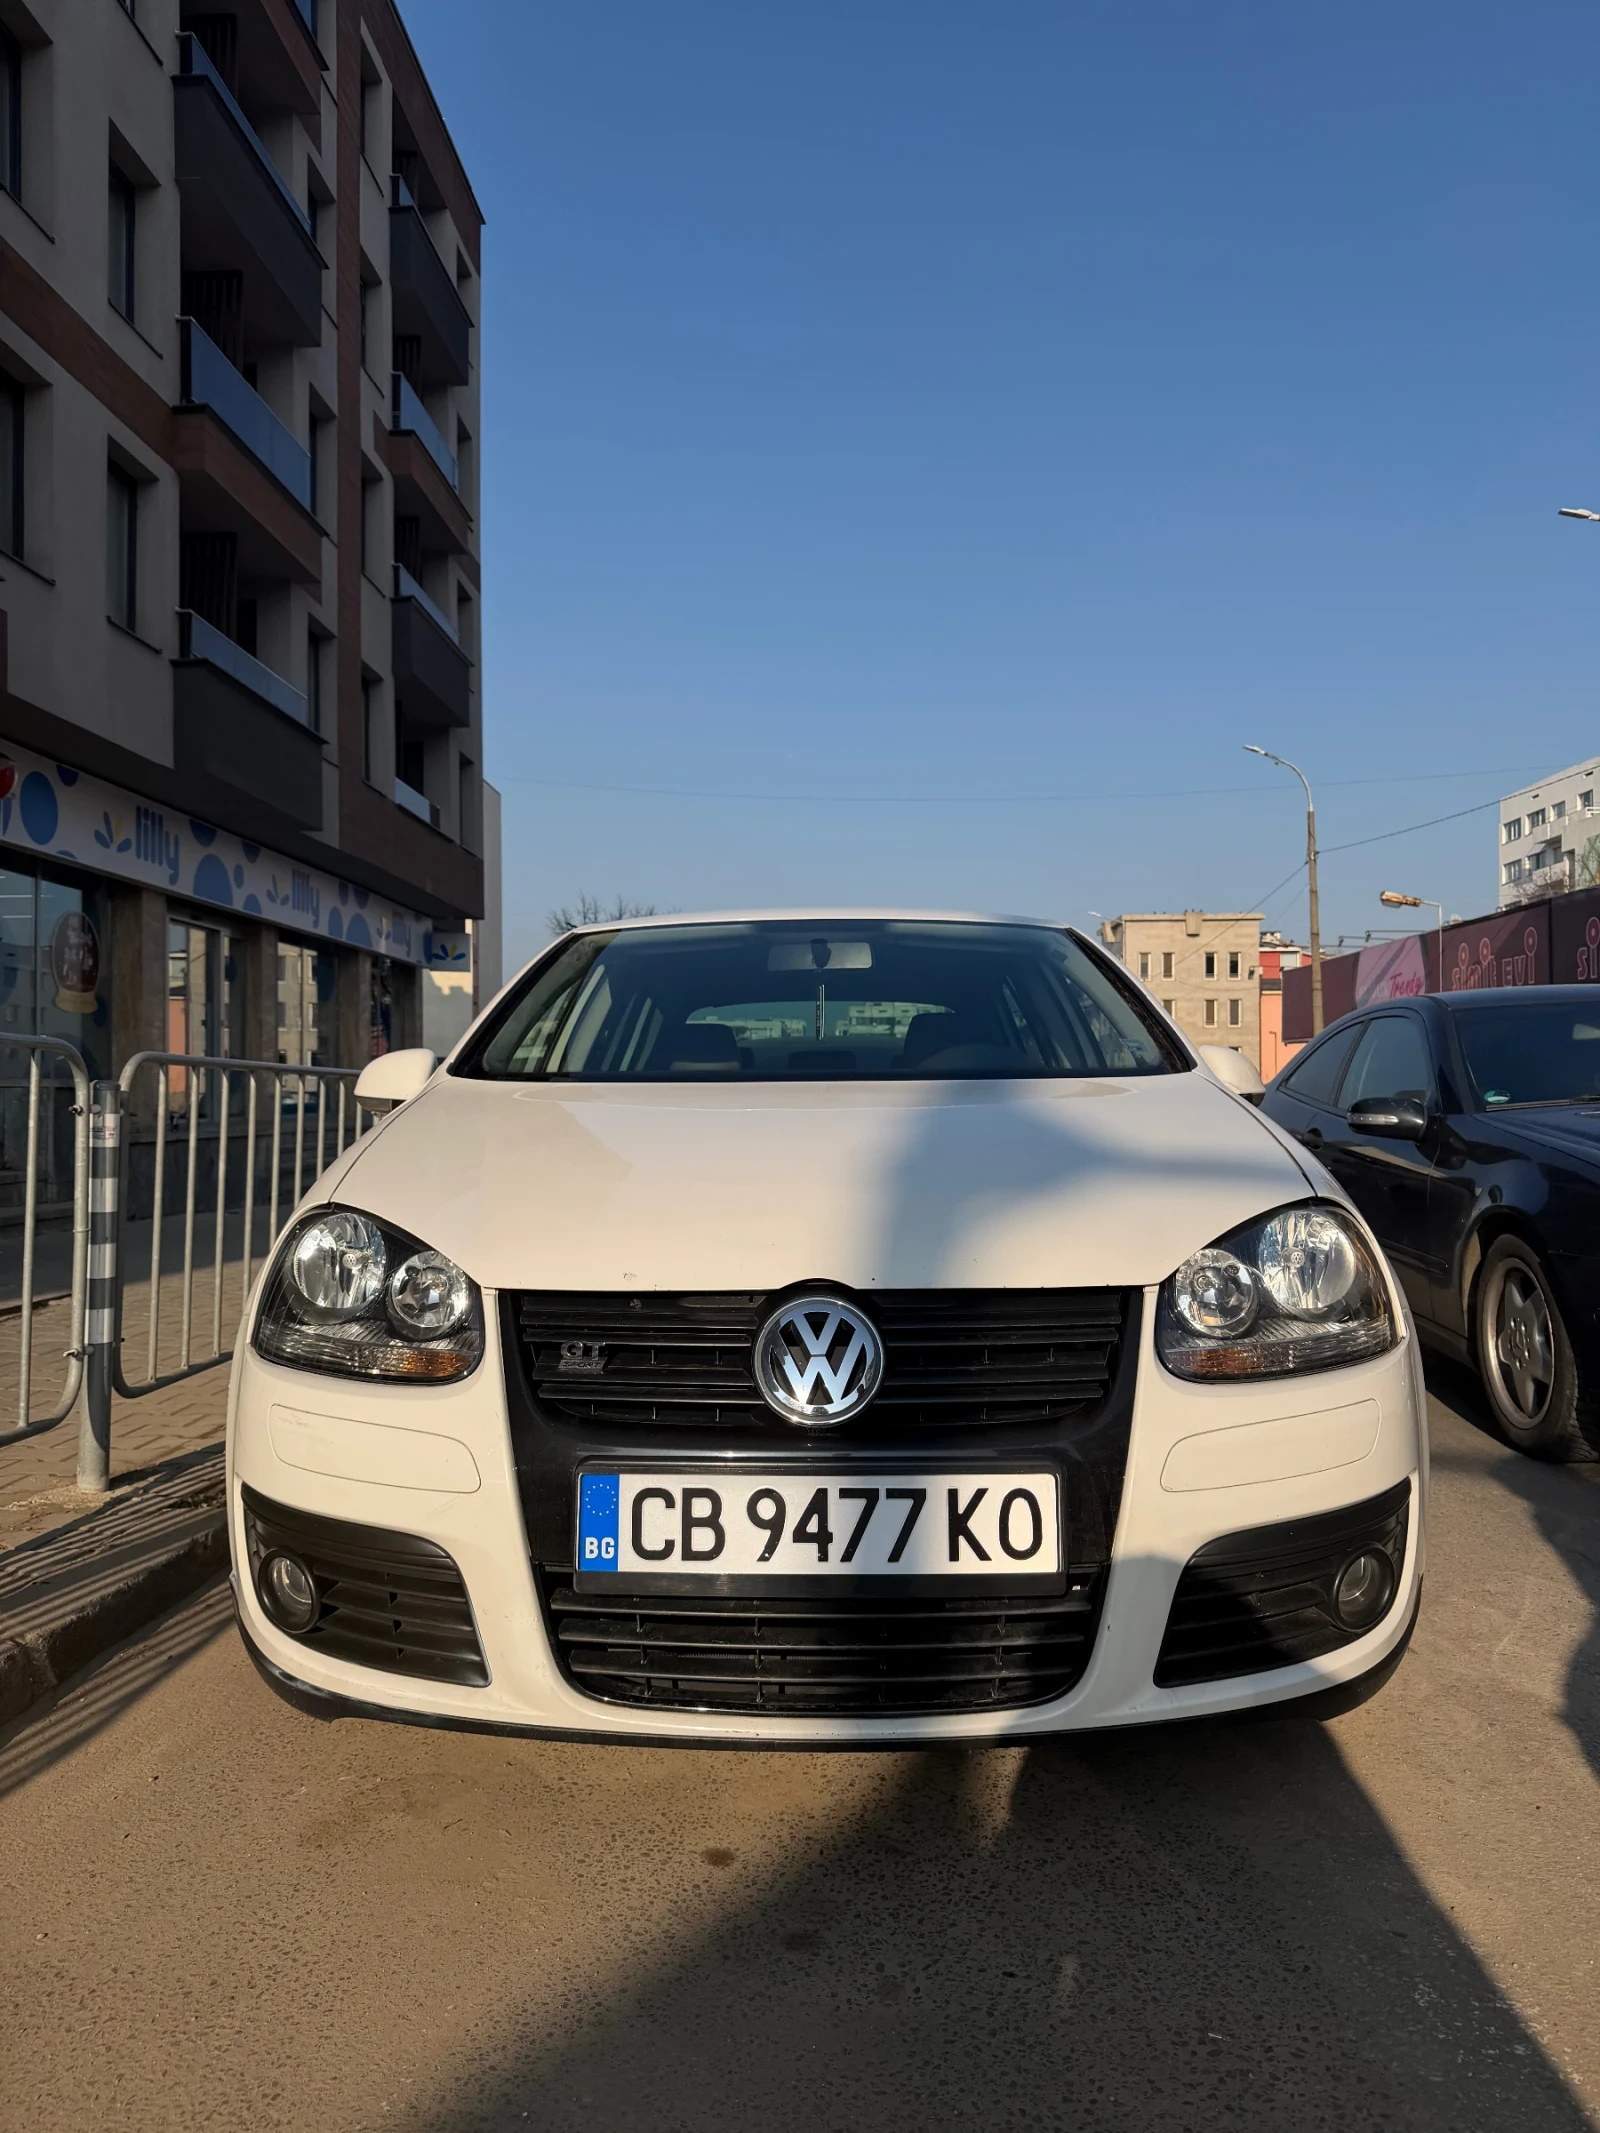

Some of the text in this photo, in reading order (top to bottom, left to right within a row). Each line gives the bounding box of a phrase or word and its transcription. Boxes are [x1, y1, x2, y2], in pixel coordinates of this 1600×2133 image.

[135, 805, 180, 885] lilly
[292, 867, 320, 928] lilly
[1389, 970, 1424, 998] Trendy
[561, 1341, 606, 1360] GT
[562, 1360, 602, 1369] SPORT
[631, 1487, 1043, 1562] CB 9477 KO
[585, 1537, 615, 1559] BG
